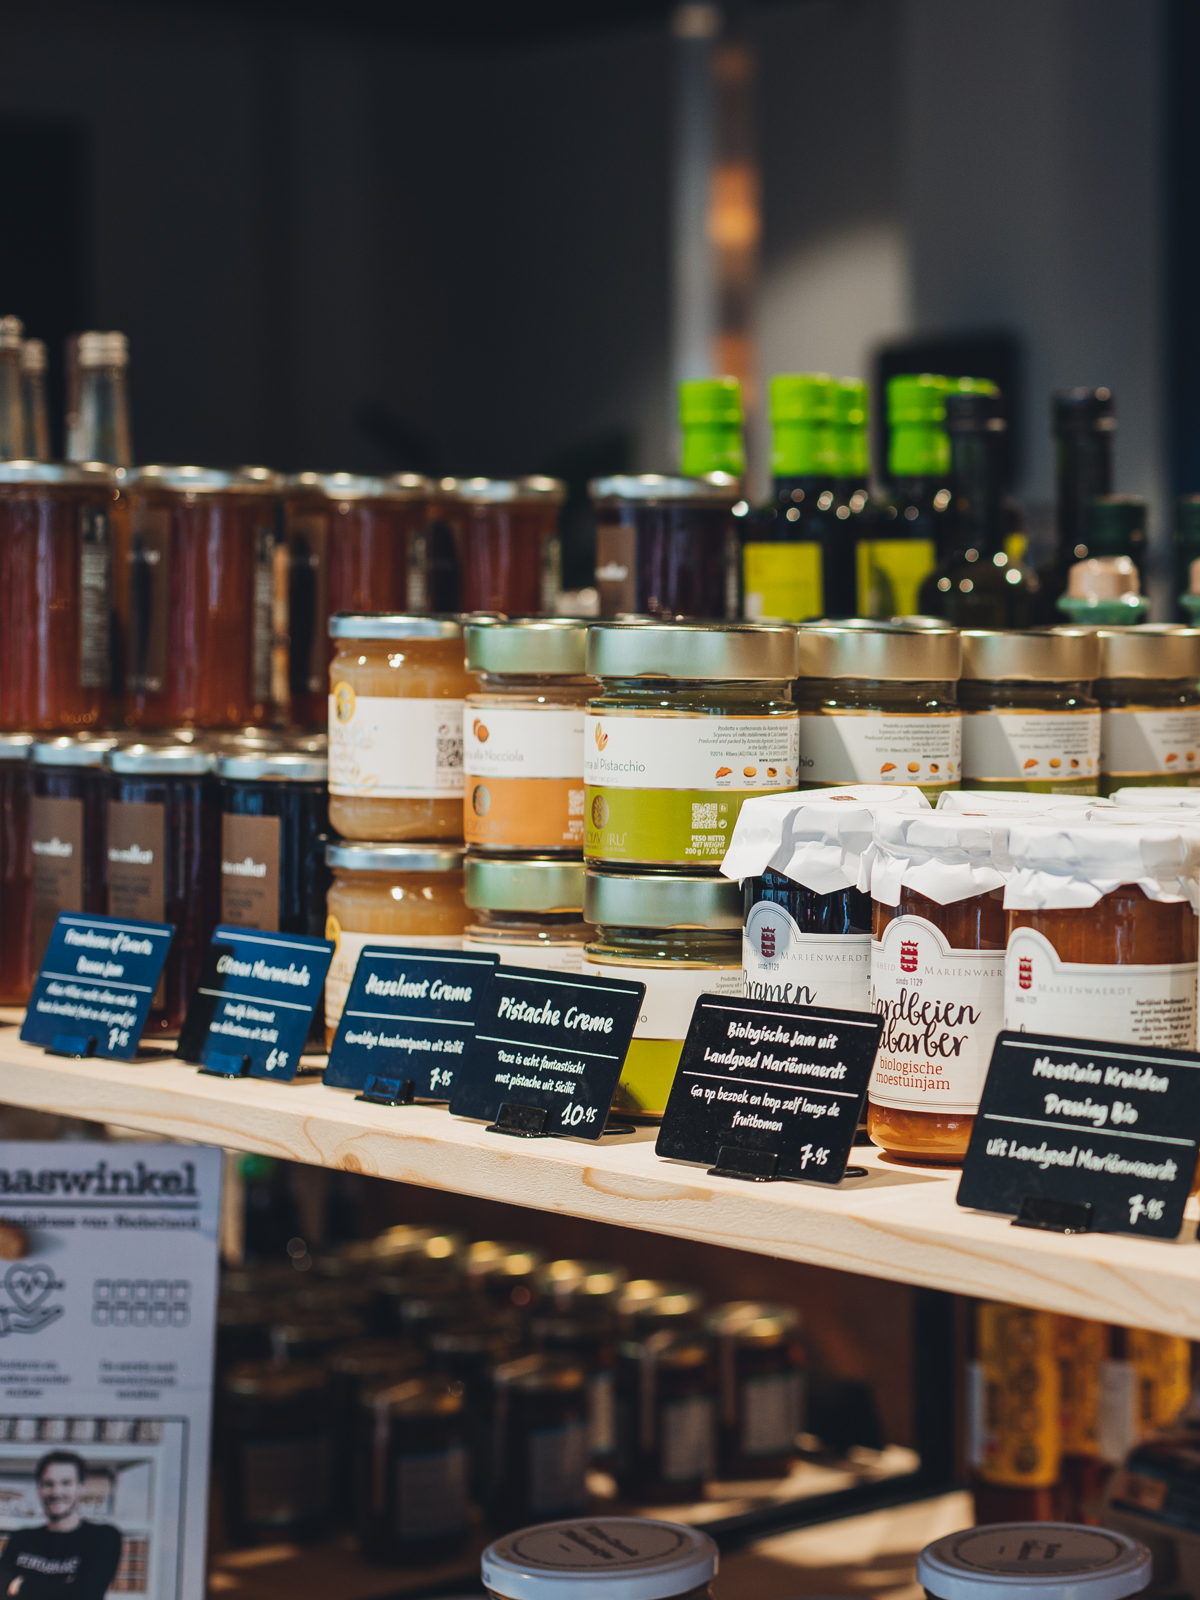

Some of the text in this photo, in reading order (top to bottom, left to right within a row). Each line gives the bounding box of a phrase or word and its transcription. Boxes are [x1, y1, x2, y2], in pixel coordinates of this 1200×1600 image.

[600, 758, 646, 772] Pistacchio
[768, 963, 779, 971] 1129
[365, 973, 473, 1002] Hazelnoot Creme
[896, 977, 923, 986] sinds 1129
[497, 996, 614, 1033] Pistache Creme
[432, 1039, 443, 1052] uit
[727, 1022, 838, 1049] Biologische Jam uit
[498, 1050, 585, 1074] Deze is echt fantastisch!
[704, 1047, 848, 1080] Landgoed Mariënwaerdt
[880, 1056, 943, 1075] biologische
[430, 1067, 454, 1091] 7.95
[495, 1073, 576, 1094] met pistache uit Sicilië
[876, 1072, 950, 1092] moestuinjam
[1032, 1056, 1170, 1093] Moestuin Kruiden
[691, 1084, 840, 1119] Ga op bezoek en loop zelf langs de
[1044, 1093, 1139, 1127] Dressing Bio
[561, 1102, 598, 1126] 10.95
[732, 1111, 783, 1132] fruitbomen
[800, 1144, 830, 1170] 7.95
[1008, 1139, 1077, 1170] Landgoed
[1076, 1148, 1178, 1181] Mariënwaerdt
